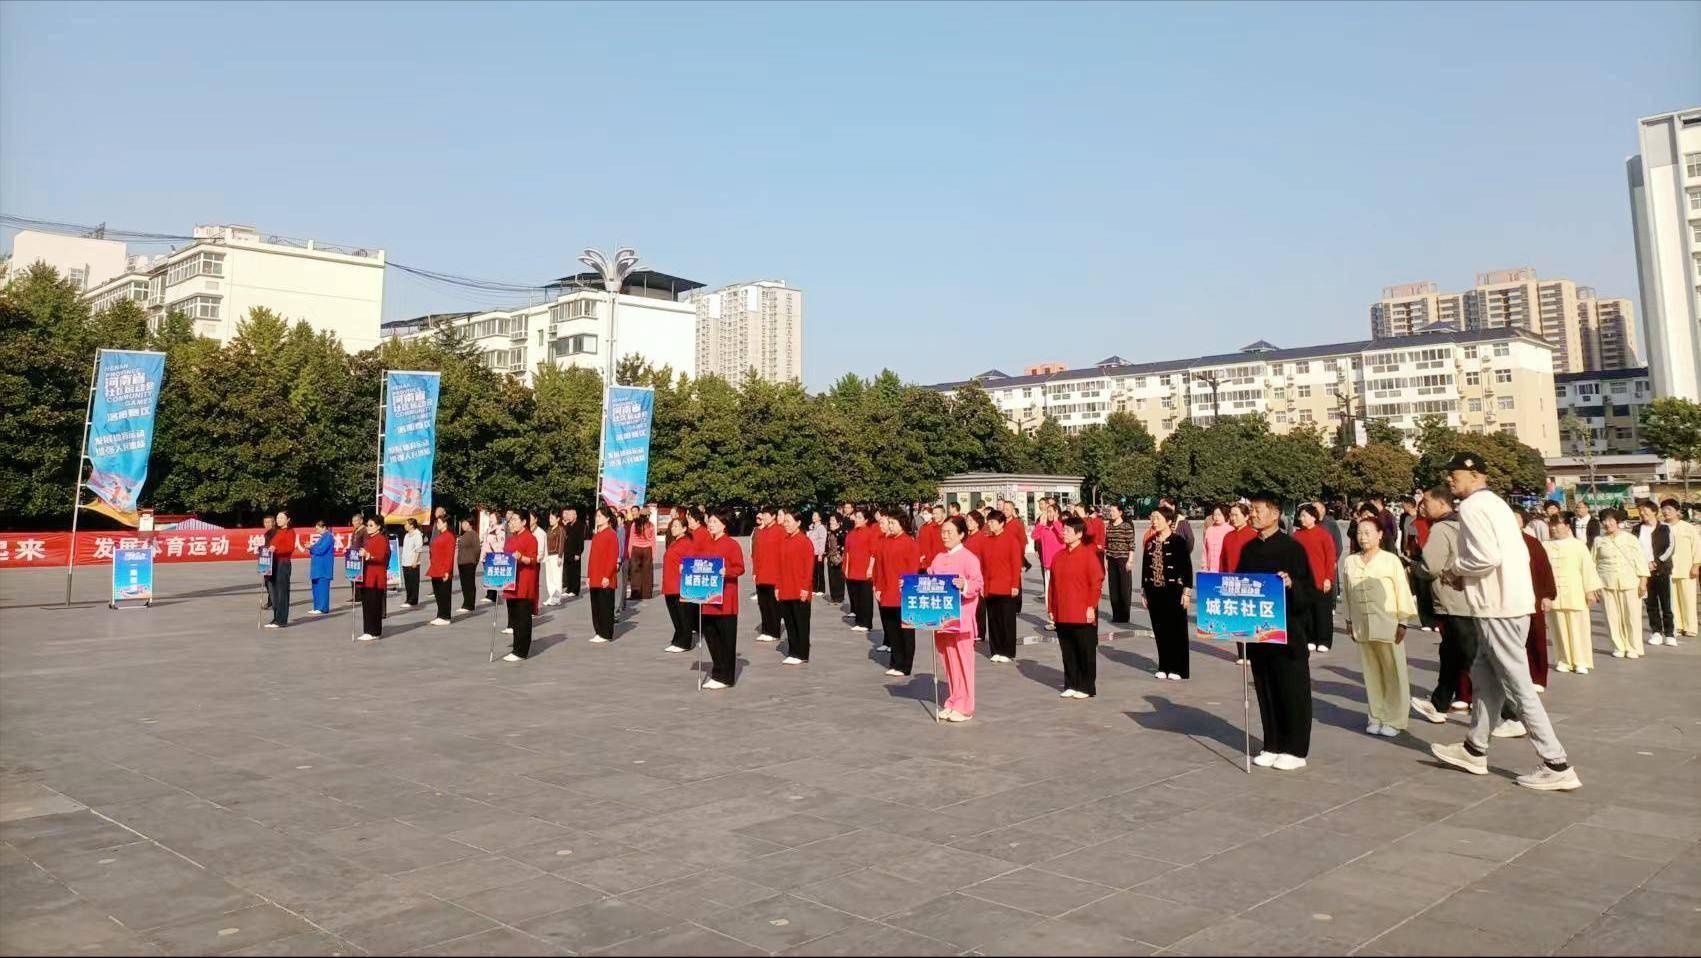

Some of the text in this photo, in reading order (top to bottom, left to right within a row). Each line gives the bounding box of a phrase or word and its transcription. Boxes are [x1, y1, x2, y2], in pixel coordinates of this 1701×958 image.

[105, 373, 145, 387] 河南省
[104, 382, 154, 398] 社区运动会
[393, 391, 425, 403] 河南省
[684, 575, 719, 588] 城西社区
[907, 595, 954, 610] 王东社区
[1205, 597, 1275, 617] 城东社区
